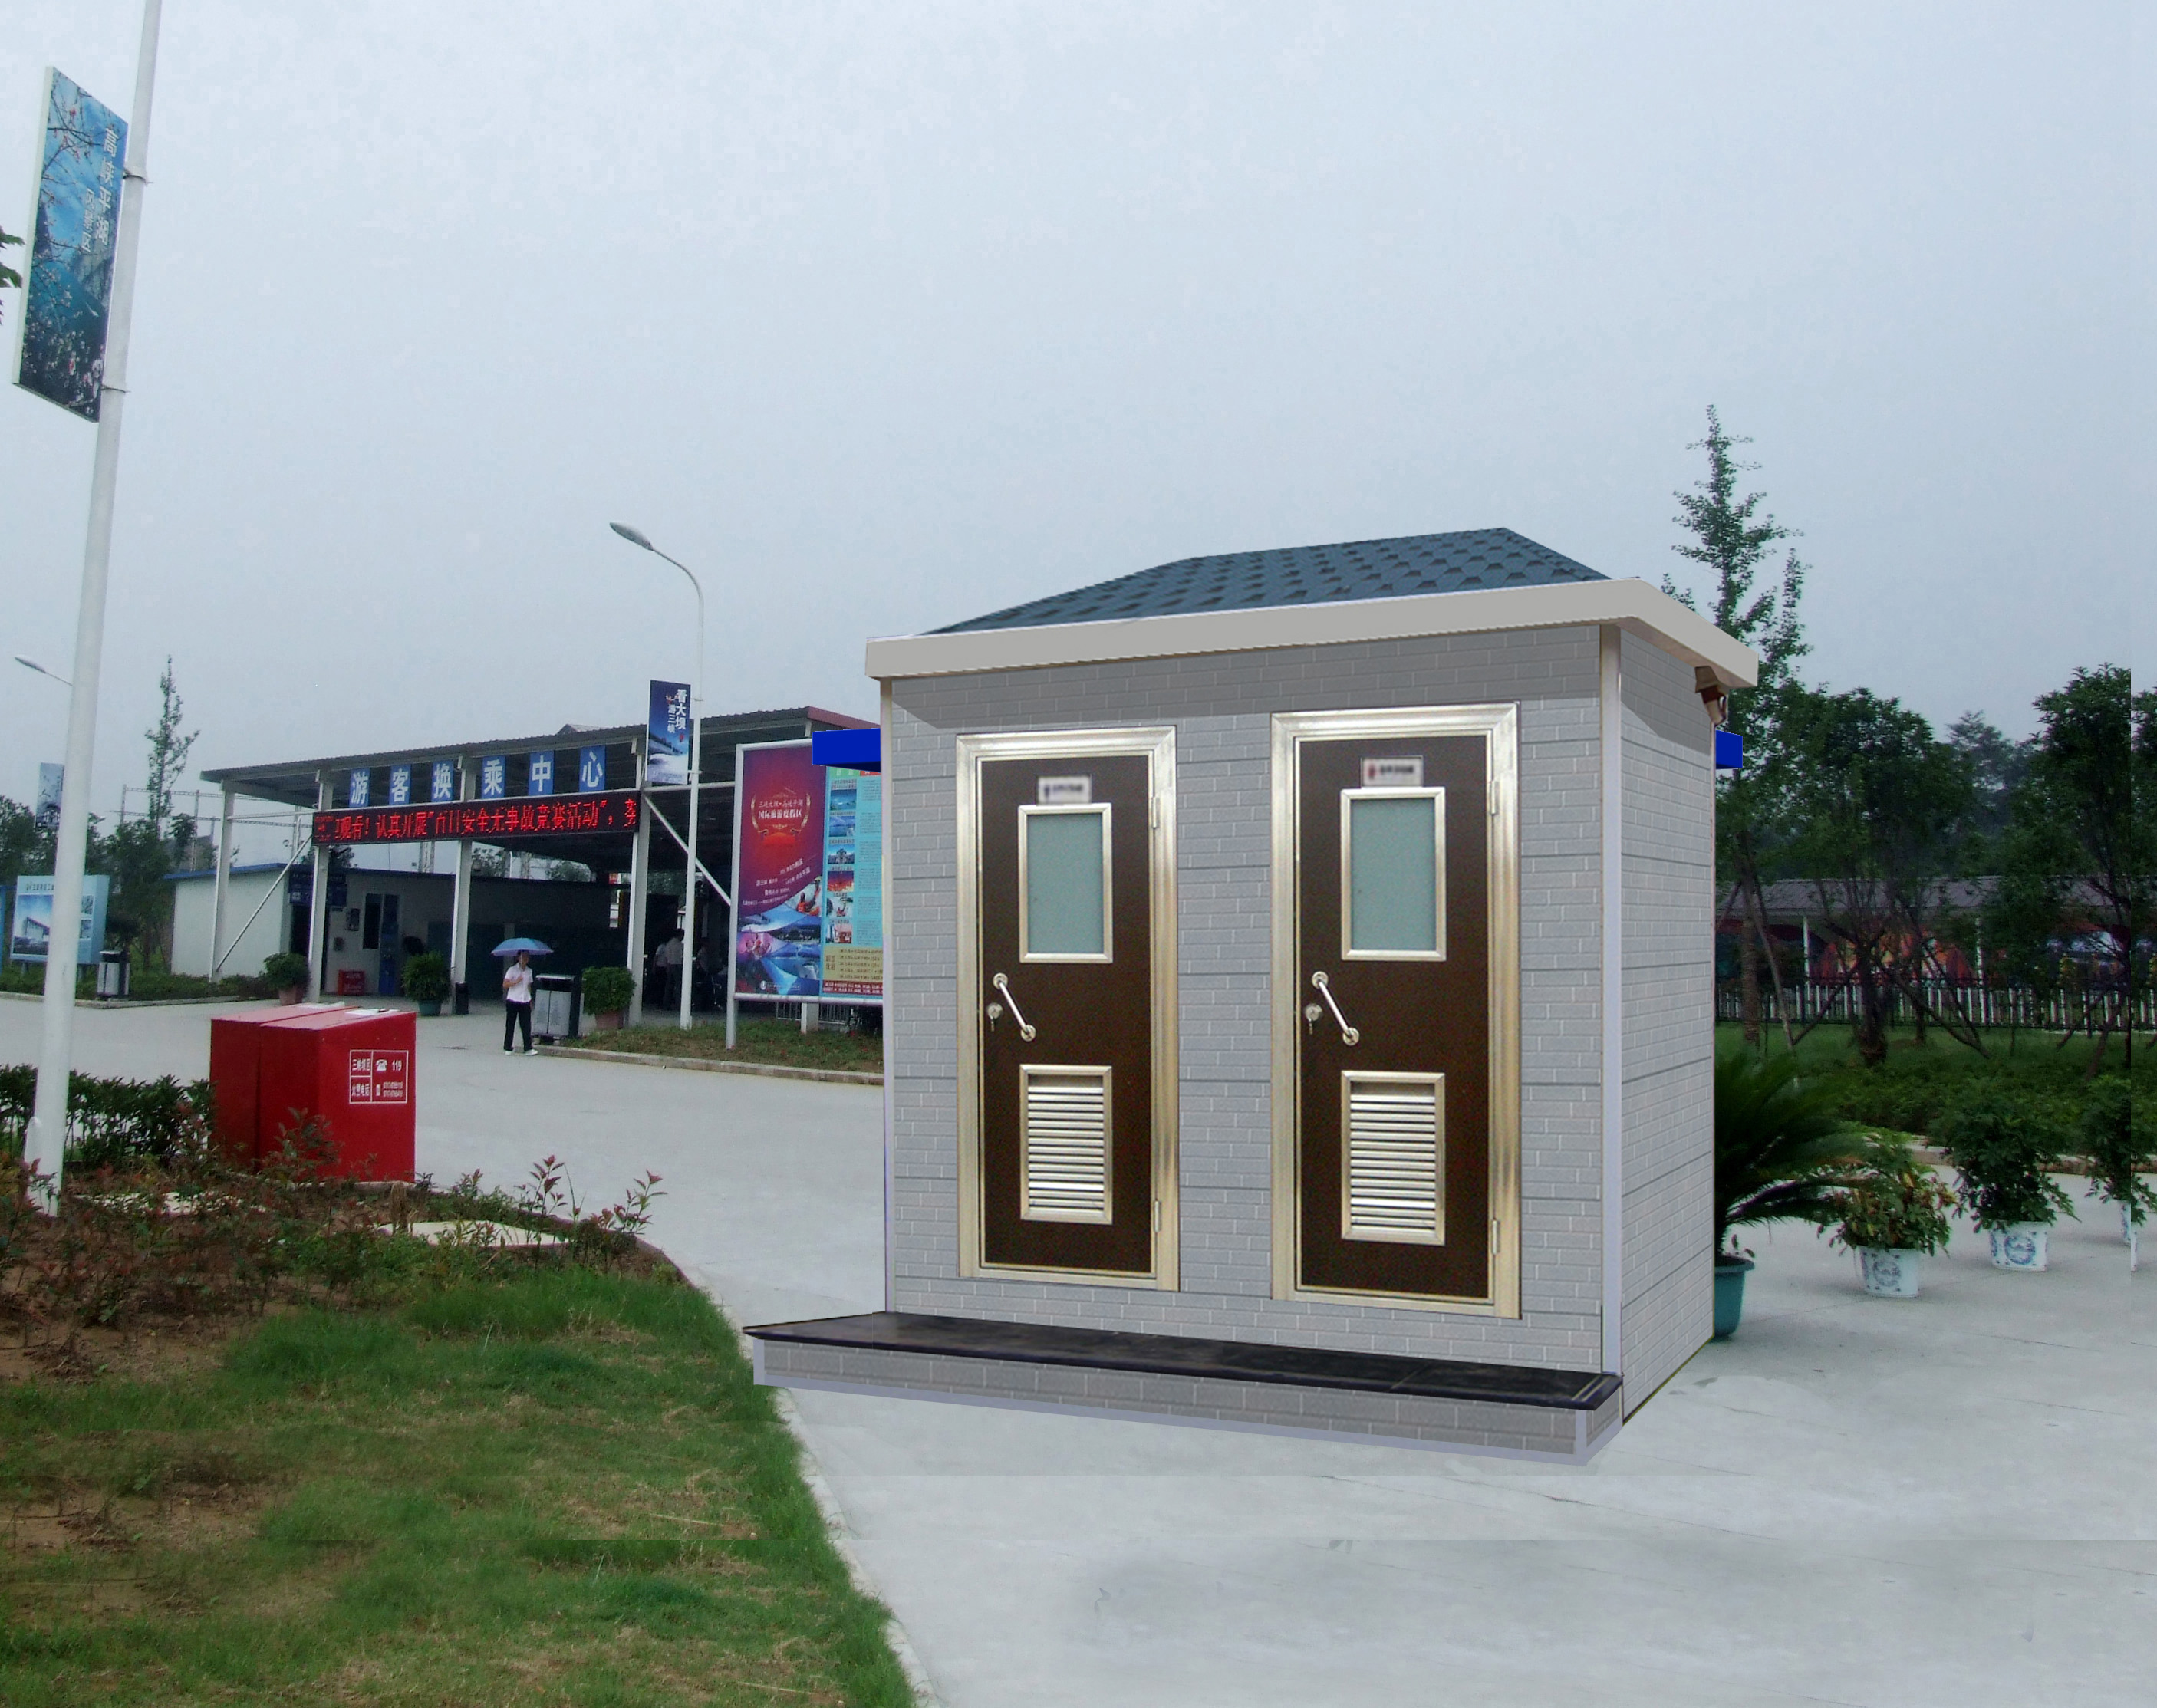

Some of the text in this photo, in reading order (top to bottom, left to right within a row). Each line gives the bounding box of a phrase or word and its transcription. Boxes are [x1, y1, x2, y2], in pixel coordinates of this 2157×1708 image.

[667, 703, 677, 734] 游三峡
[675, 689, 687, 730] 看大坝
[351, 751, 604, 805] 游客换乘中心
[392, 1060, 402, 1071] 119
